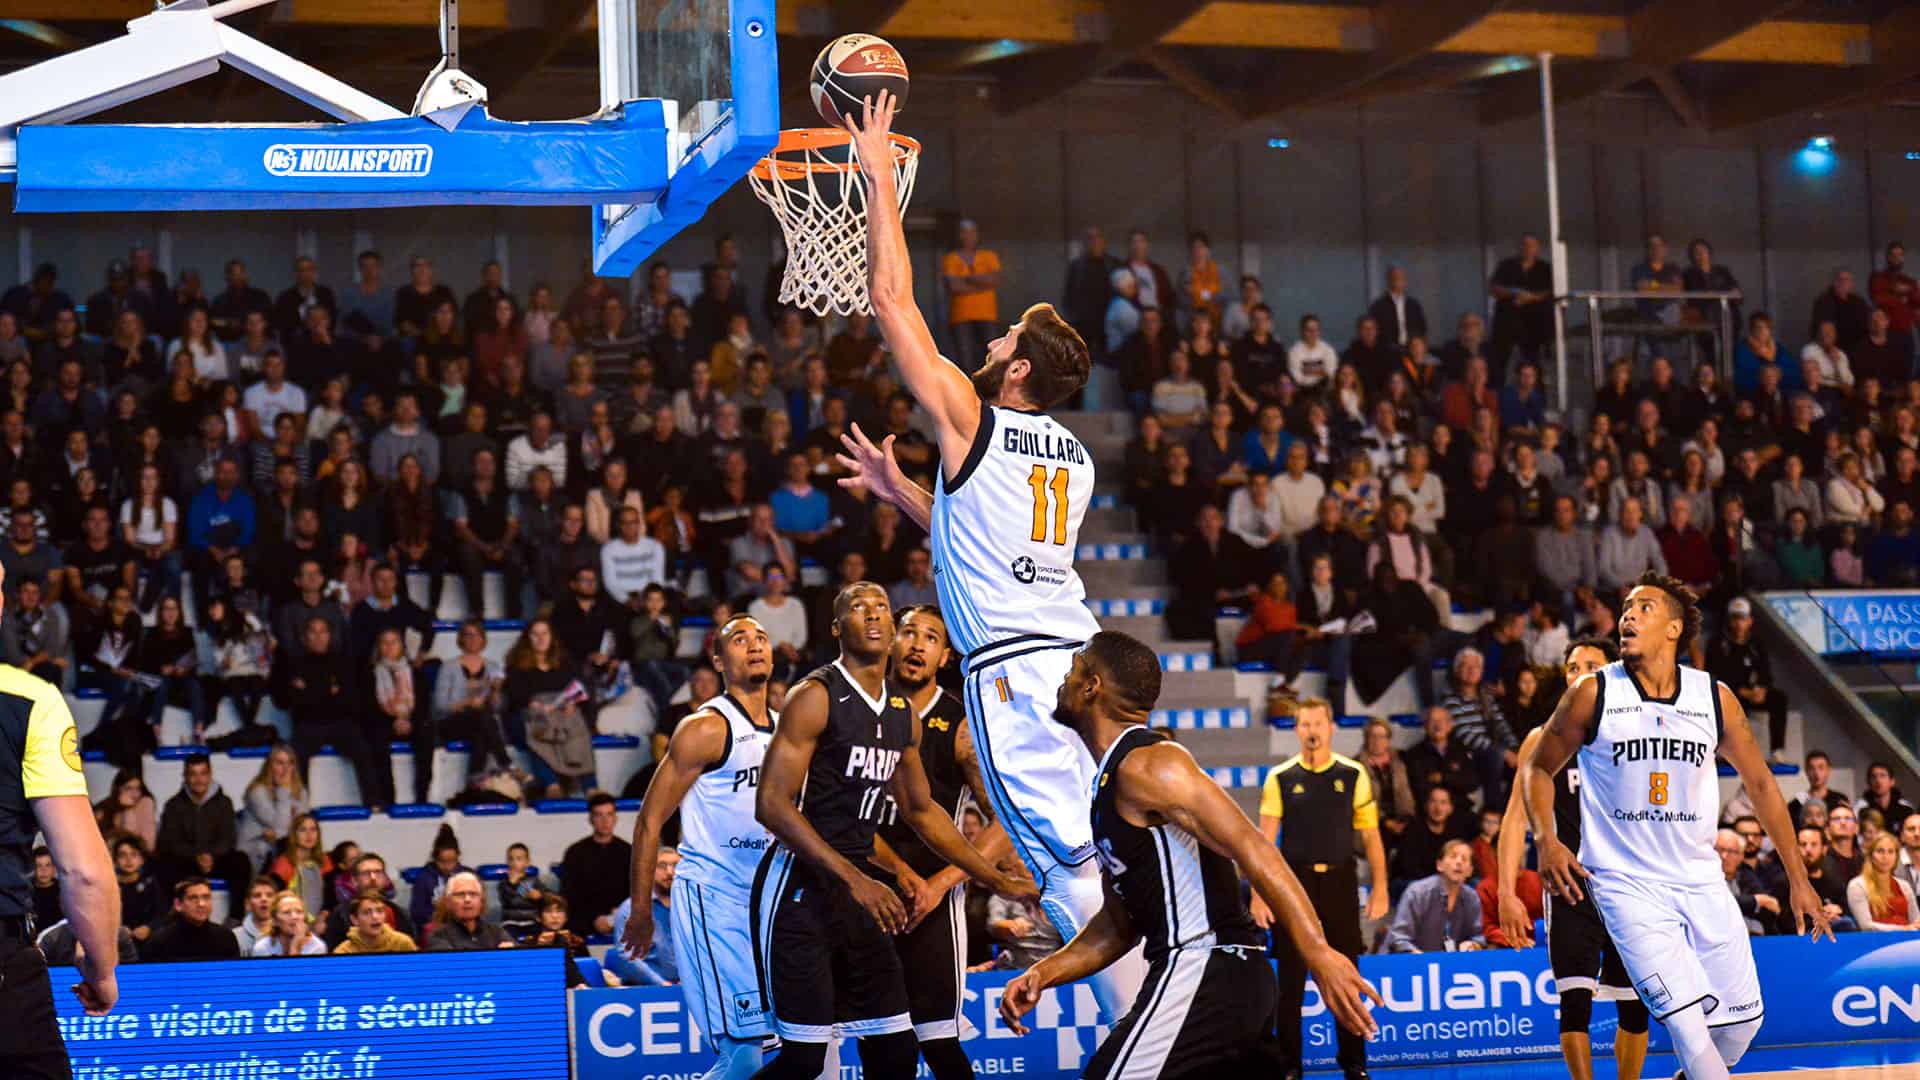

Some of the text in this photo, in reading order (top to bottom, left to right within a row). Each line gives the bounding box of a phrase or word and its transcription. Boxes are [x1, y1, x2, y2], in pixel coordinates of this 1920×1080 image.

[299, 149, 427, 172] NOUANSPORT
[1003, 427, 1085, 465] GUILLARD
[1028, 464, 1069, 546] 11
[1612, 738, 1708, 768] POITIERS
[858, 786, 881, 820] 11
[1648, 771, 1669, 806] 8
[1664, 811, 1697, 823] Mutue
[149, 1003, 255, 1038] vision
[263, 1000, 307, 1033] de
[316, 998, 347, 1031] la
[356, 992, 496, 1029] sécurité
[1308, 1020, 1333, 1046] Si
[1405, 1012, 1534, 1041] ensemble
[1456, 1046, 1513, 1058] BOULANGER
